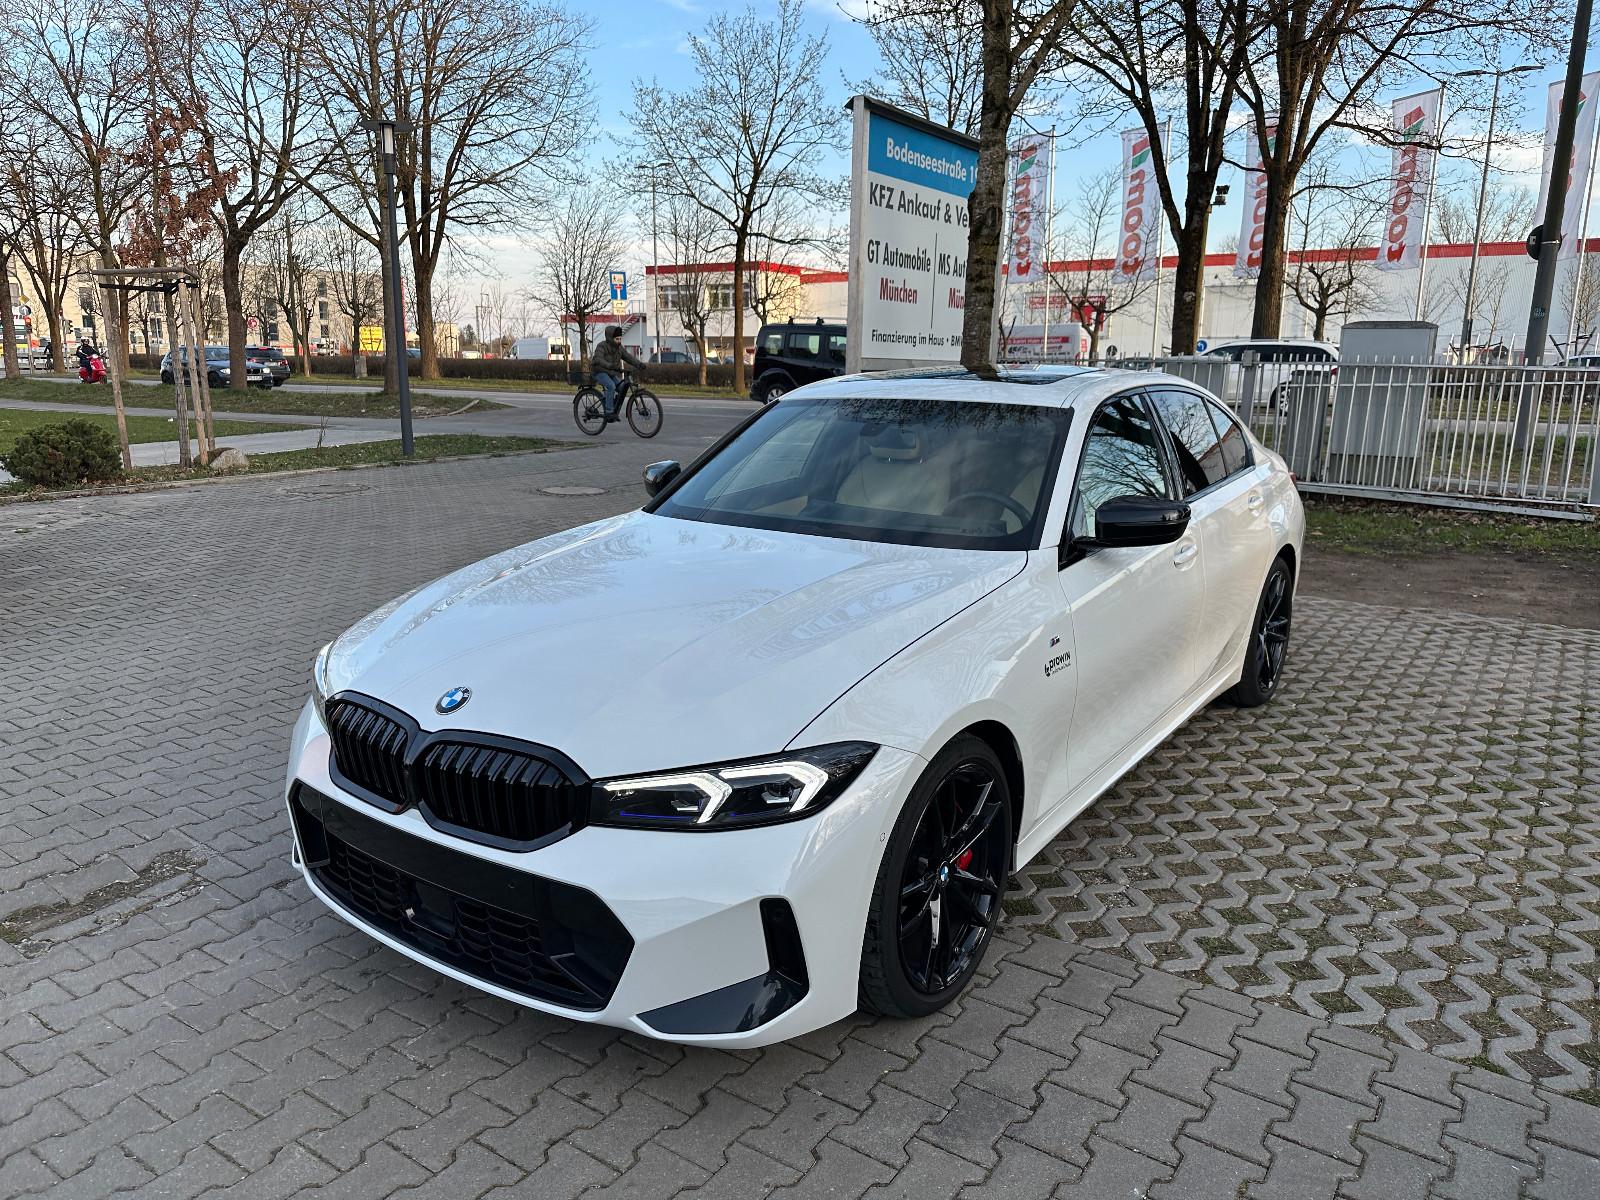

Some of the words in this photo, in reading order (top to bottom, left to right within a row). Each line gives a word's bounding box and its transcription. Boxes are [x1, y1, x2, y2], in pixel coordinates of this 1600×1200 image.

[886, 137, 967, 181] Bodenseestraße
[869, 181, 895, 210] KFZ
[897, 190, 941, 221] Ankauf
[943, 202, 952, 224] &
[867, 239, 881, 264] GT
[882, 242, 931, 273] Automobile
[938, 252, 951, 275] MS
[880, 277, 918, 304] München
[871, 328, 917, 348] Finanzierung
[918, 332, 927, 345] im
[928, 333, 945, 347] Haus
